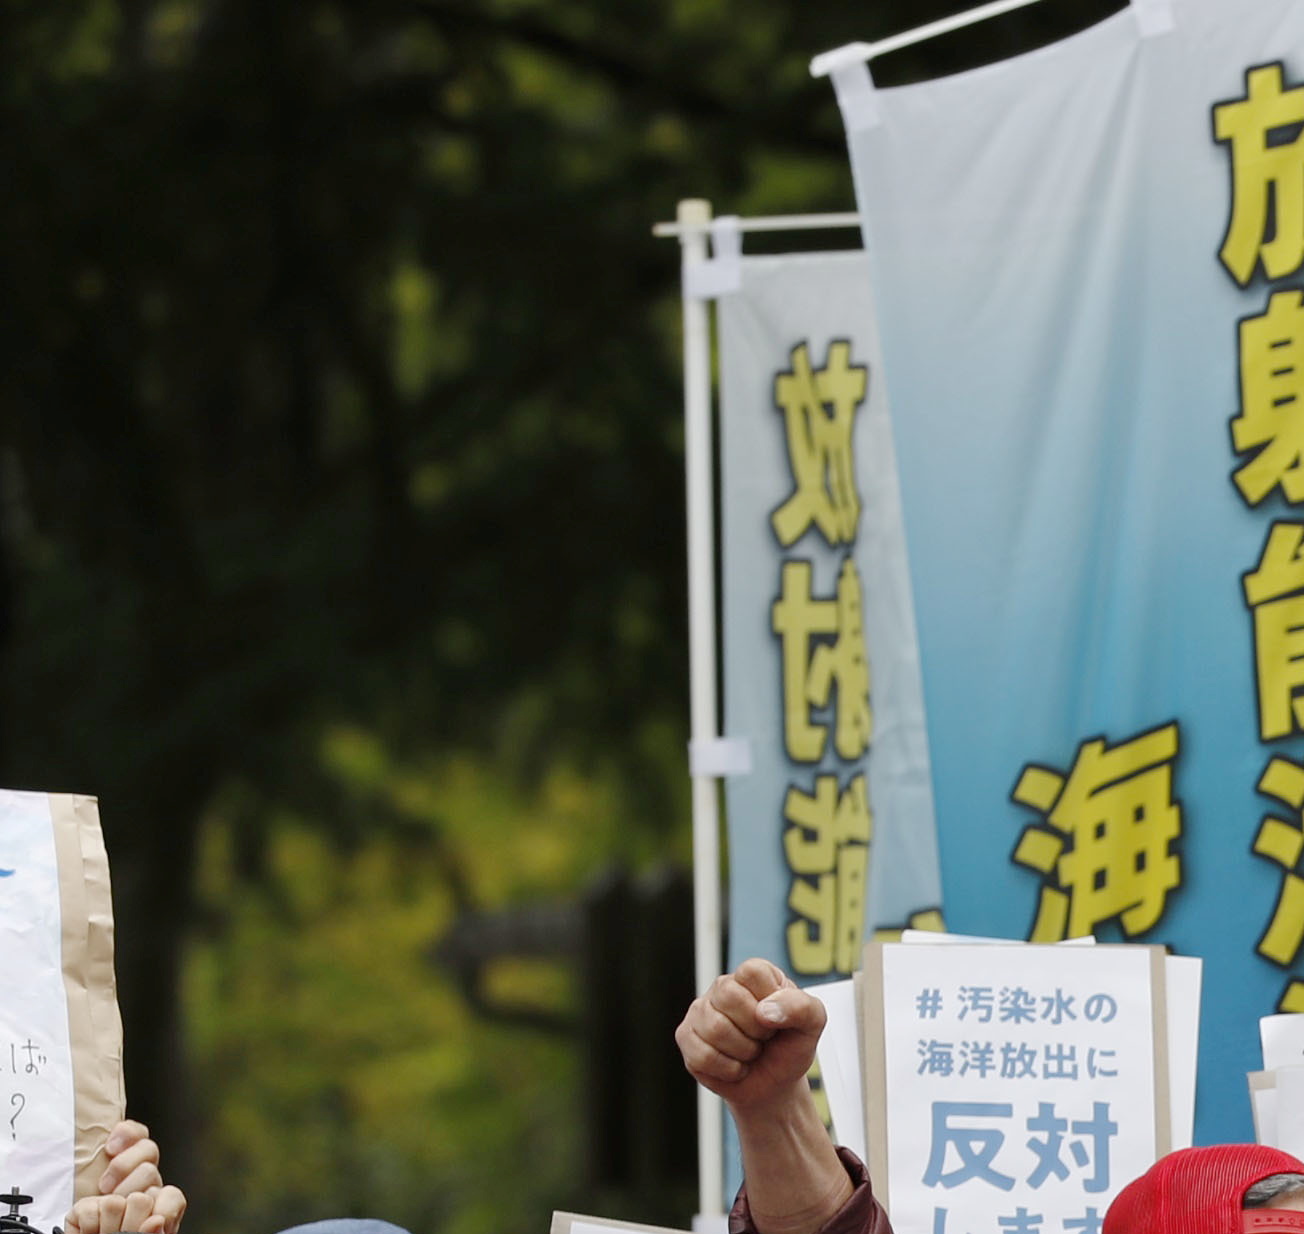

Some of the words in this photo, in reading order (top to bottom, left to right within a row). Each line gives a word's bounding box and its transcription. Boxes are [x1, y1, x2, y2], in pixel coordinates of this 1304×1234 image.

[917, 1040, 1119, 1081] 海洋放出に
[922, 1101, 1119, 1194] 反対
